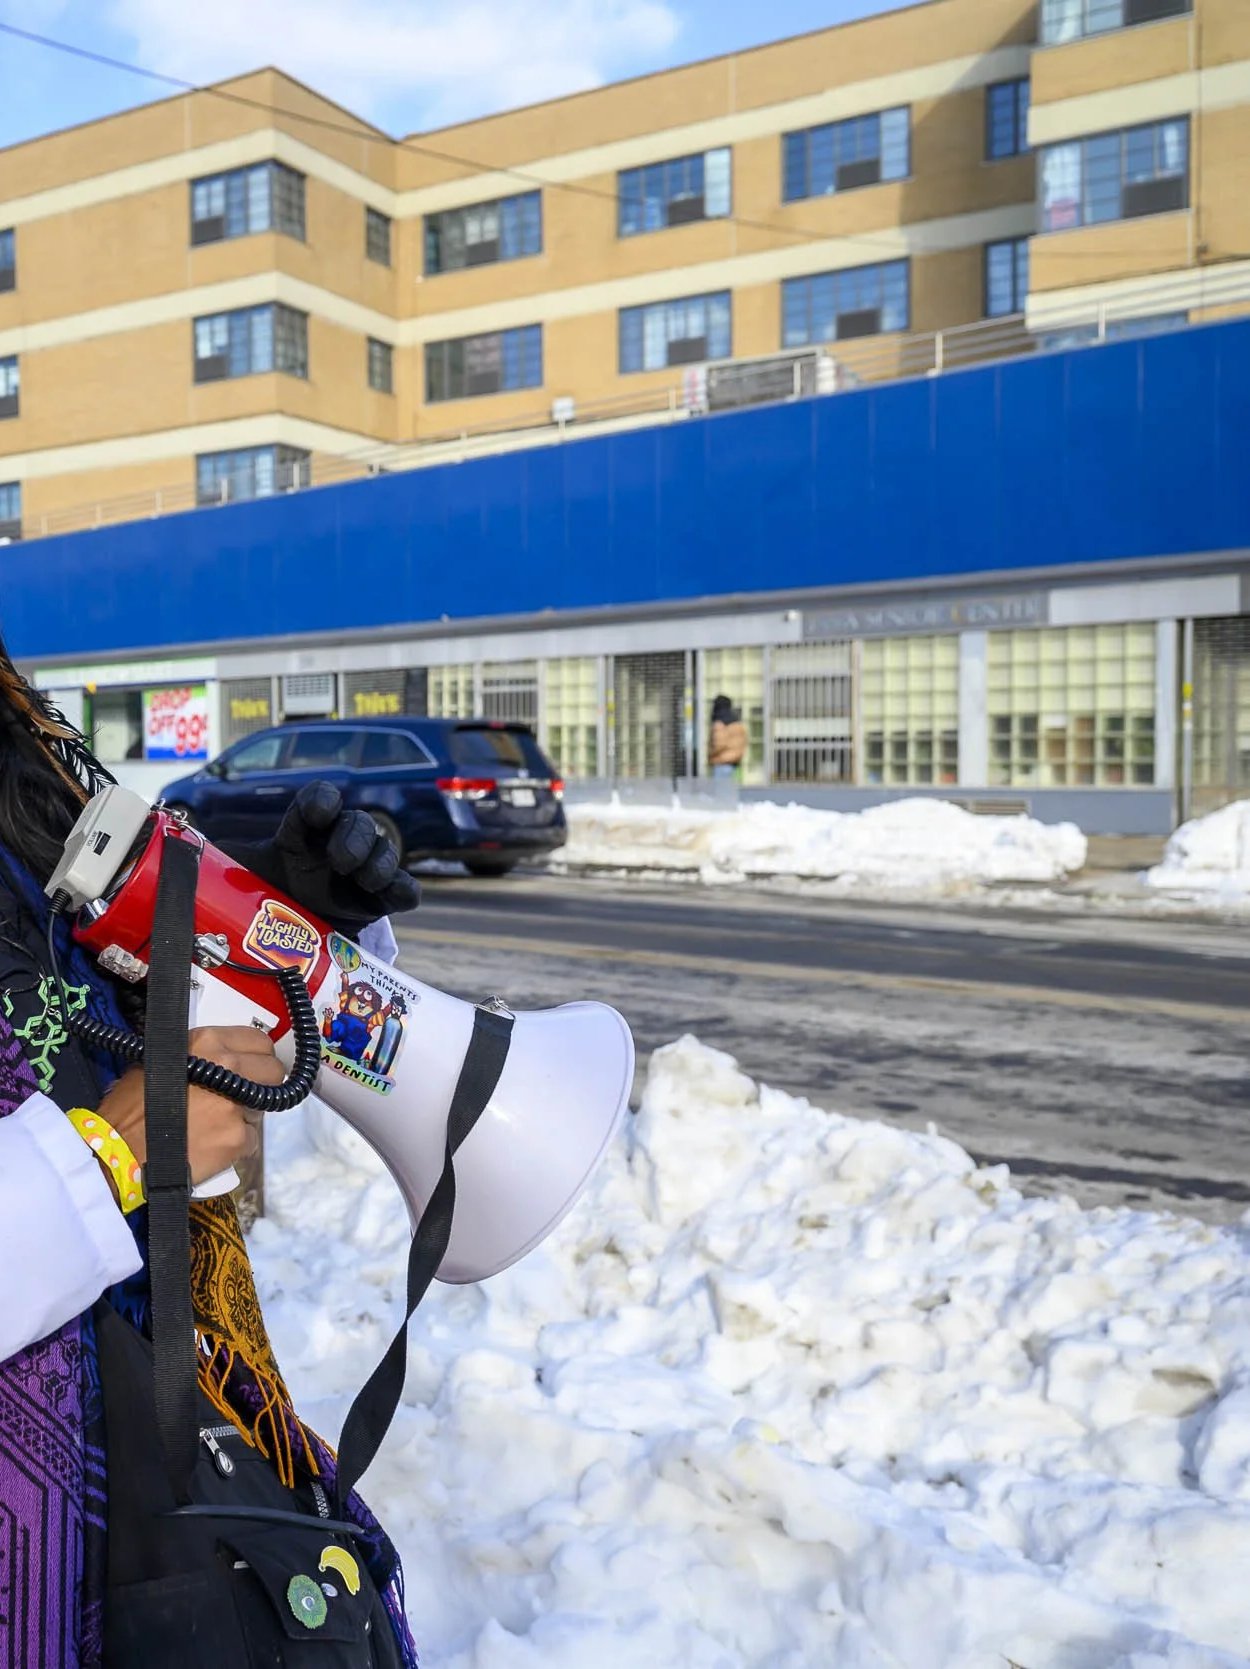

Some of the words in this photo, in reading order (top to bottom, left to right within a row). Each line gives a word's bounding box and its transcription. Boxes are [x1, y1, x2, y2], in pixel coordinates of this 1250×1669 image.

[257, 921, 314, 954] TOASTED
[261, 913, 309, 940] LIGHTLY
[361, 961, 376, 973] MY
[377, 970, 417, 1001] PARENTS
[369, 974, 399, 997] THINK
[321, 1054, 330, 1064] A
